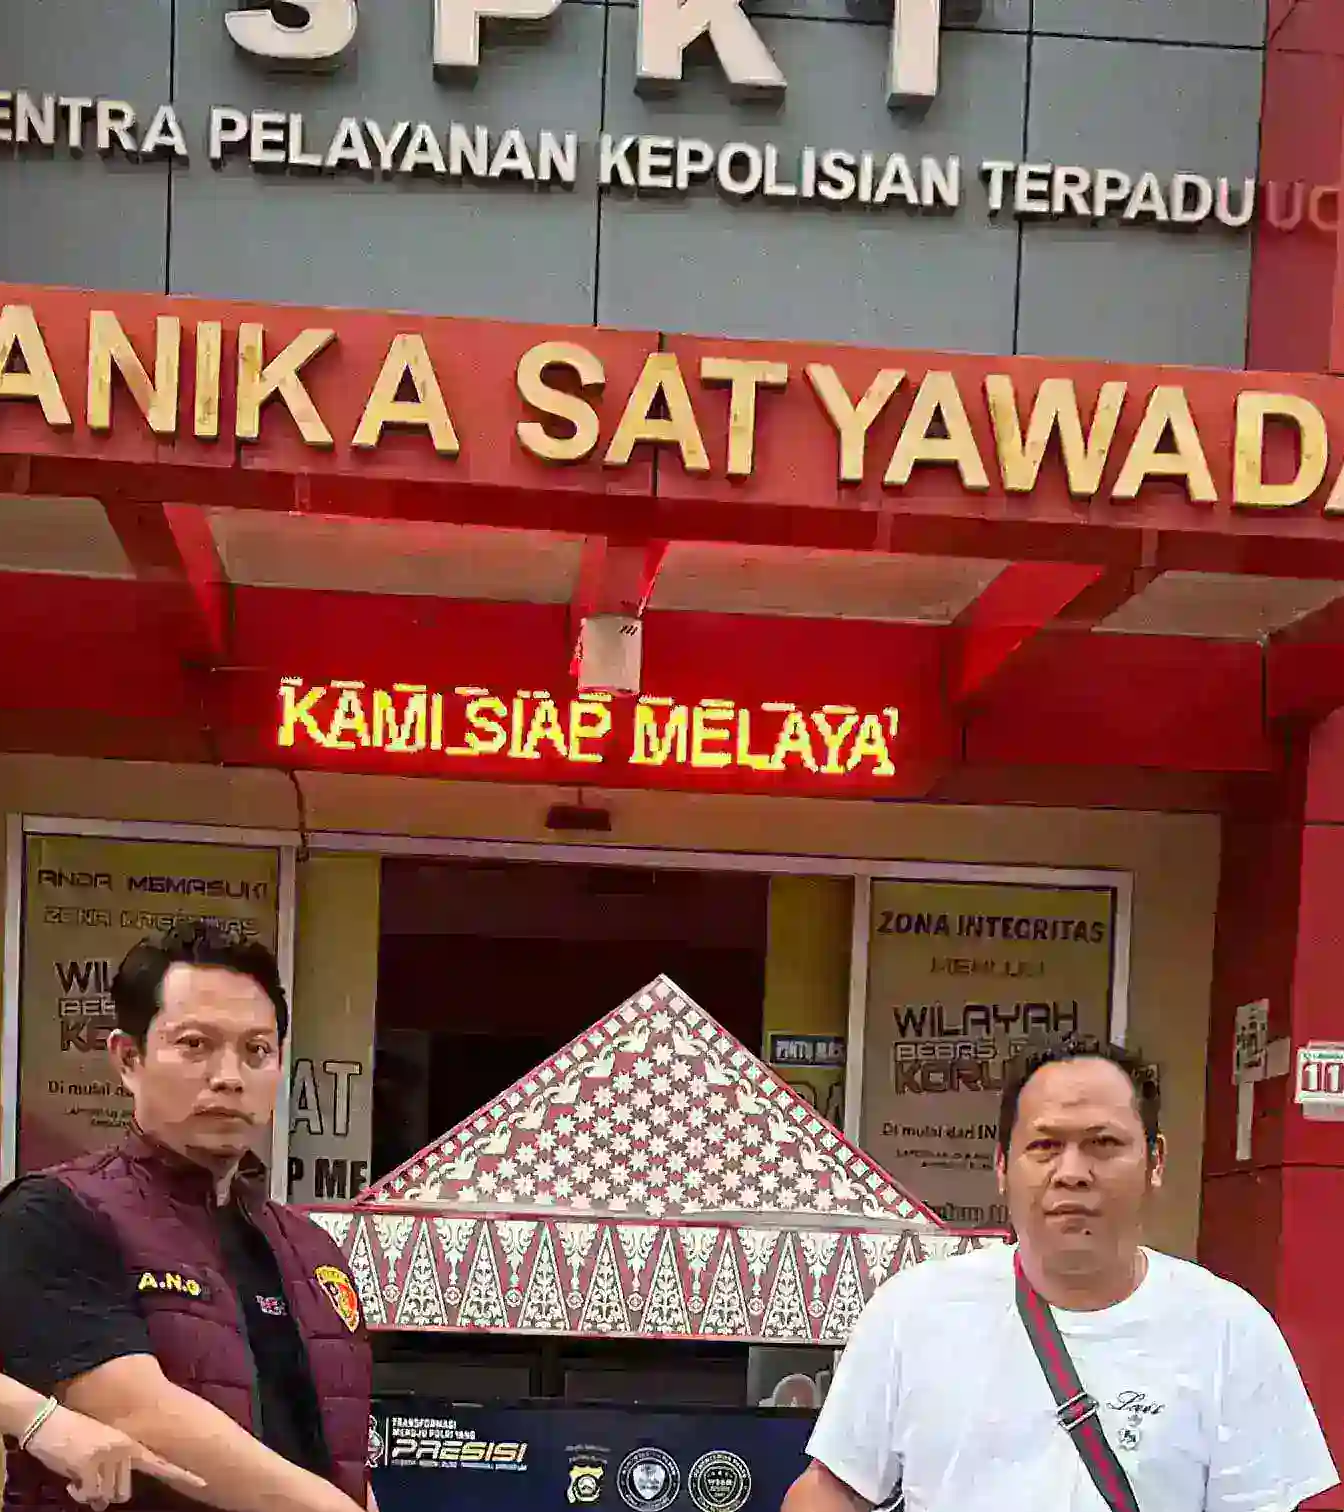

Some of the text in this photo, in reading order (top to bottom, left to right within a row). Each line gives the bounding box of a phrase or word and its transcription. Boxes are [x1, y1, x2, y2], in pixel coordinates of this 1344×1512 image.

[209, 106, 579, 183] PELAYANAN
[600, 134, 960, 207] KEPOLISIAN
[981, 160, 1255, 228] TERPADU
[277, 677, 443, 752] KAMI
[446, 686, 613, 763] SIAP
[877, 910, 951, 937] ZONA
[892, 1000, 1079, 1039] WILAYAH
[391, 1438, 529, 1463] PRESISI
